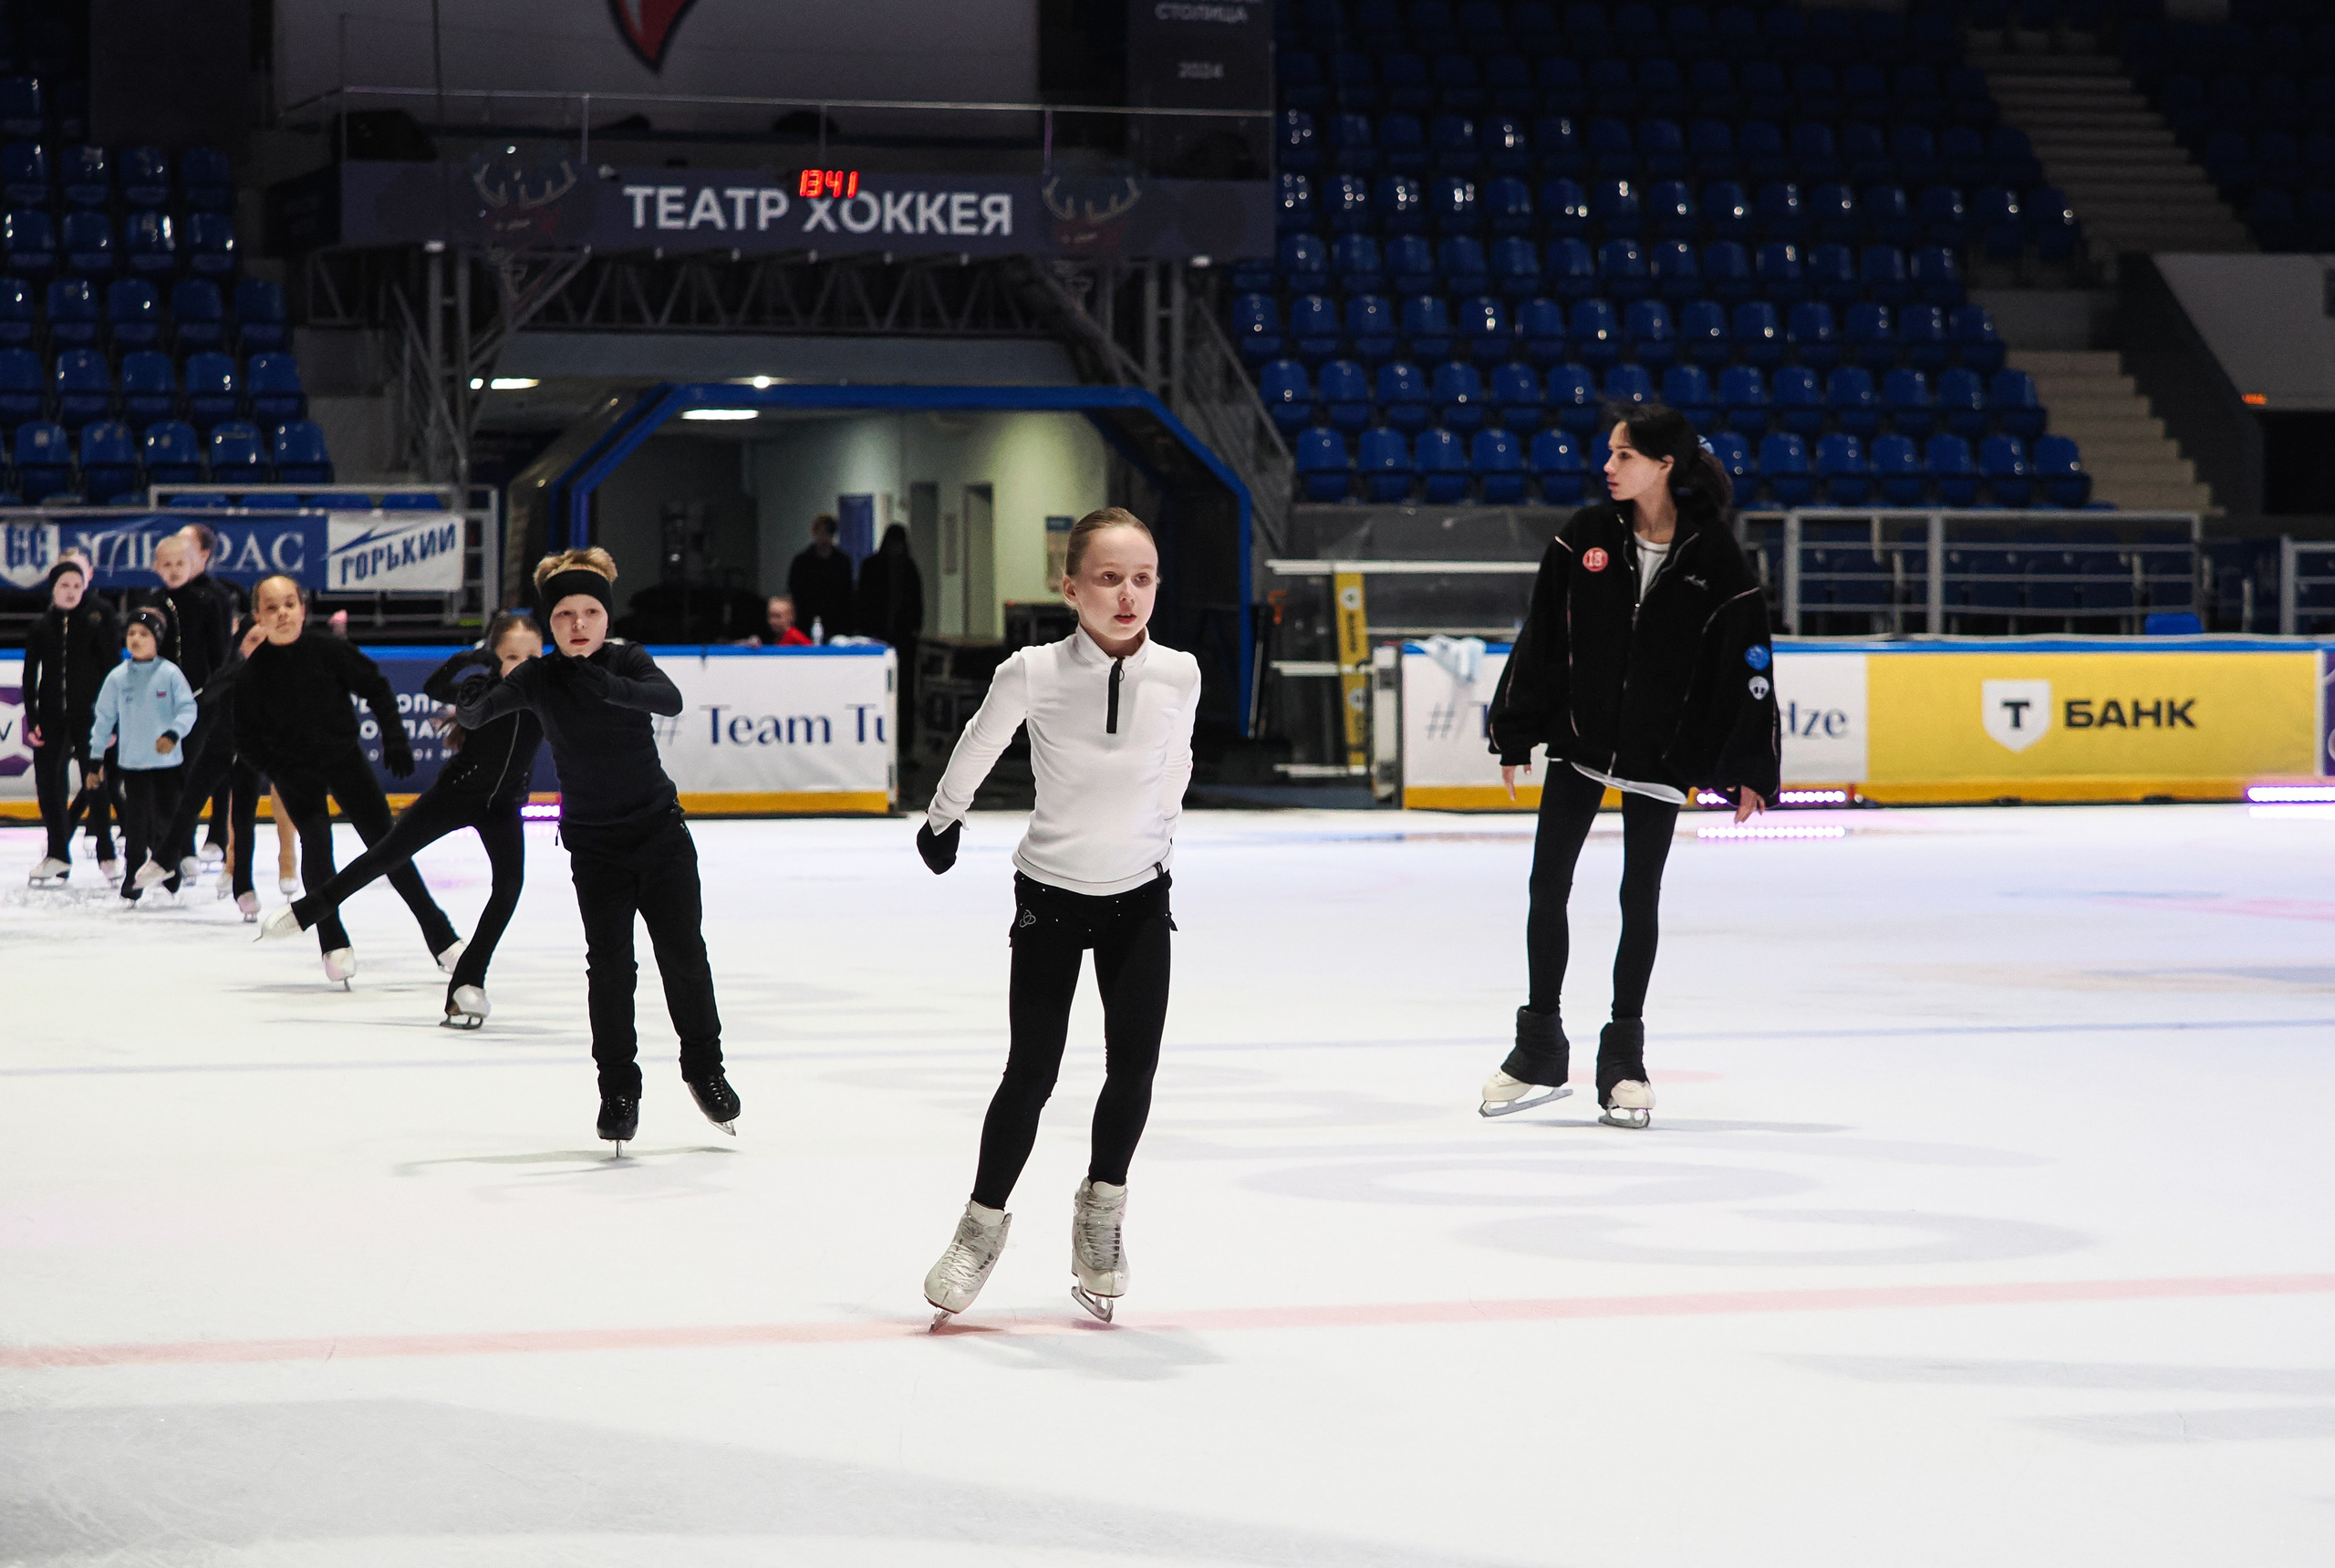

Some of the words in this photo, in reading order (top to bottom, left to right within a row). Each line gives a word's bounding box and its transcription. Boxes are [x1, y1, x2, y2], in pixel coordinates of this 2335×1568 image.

[1155, 3, 1249, 23] СТОЛИЦА
[623, 184, 790, 232] ТЕАТР
[802, 189, 1013, 236] ХОККЕЯ
[699, 704, 833, 748] Team
[2063, 698, 2199, 730] БАНК
